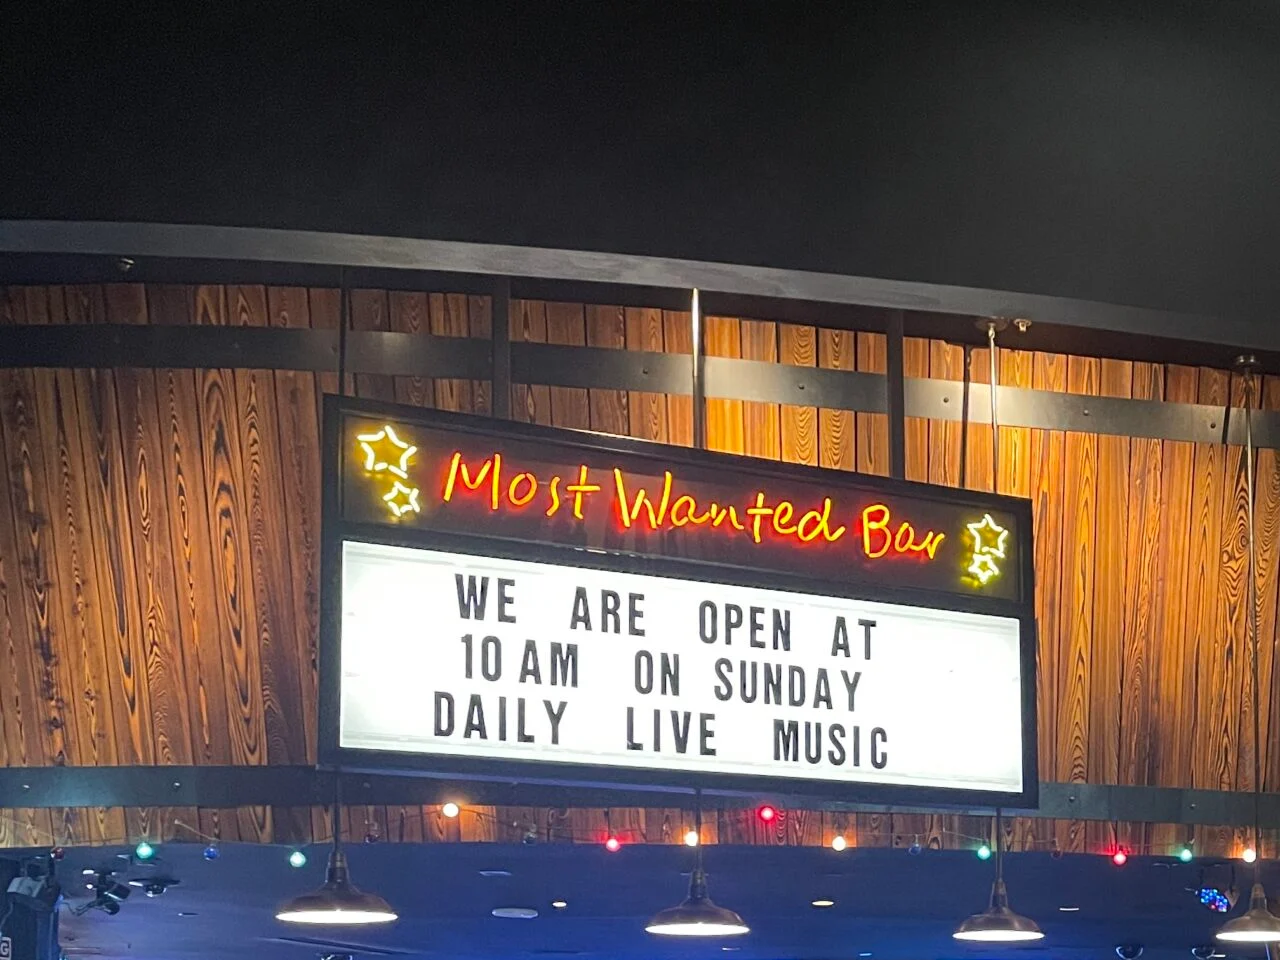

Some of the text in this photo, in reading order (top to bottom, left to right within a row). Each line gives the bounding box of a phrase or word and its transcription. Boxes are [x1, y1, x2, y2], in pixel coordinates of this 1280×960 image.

[443, 452, 946, 560] Most Wanted Bar
[455, 573, 878, 661] WE ARE OPEN AT
[635, 650, 680, 697] ON
[713, 658, 862, 713] SUNDAY
[433, 691, 890, 771] DAILY LIVE MUSIC
